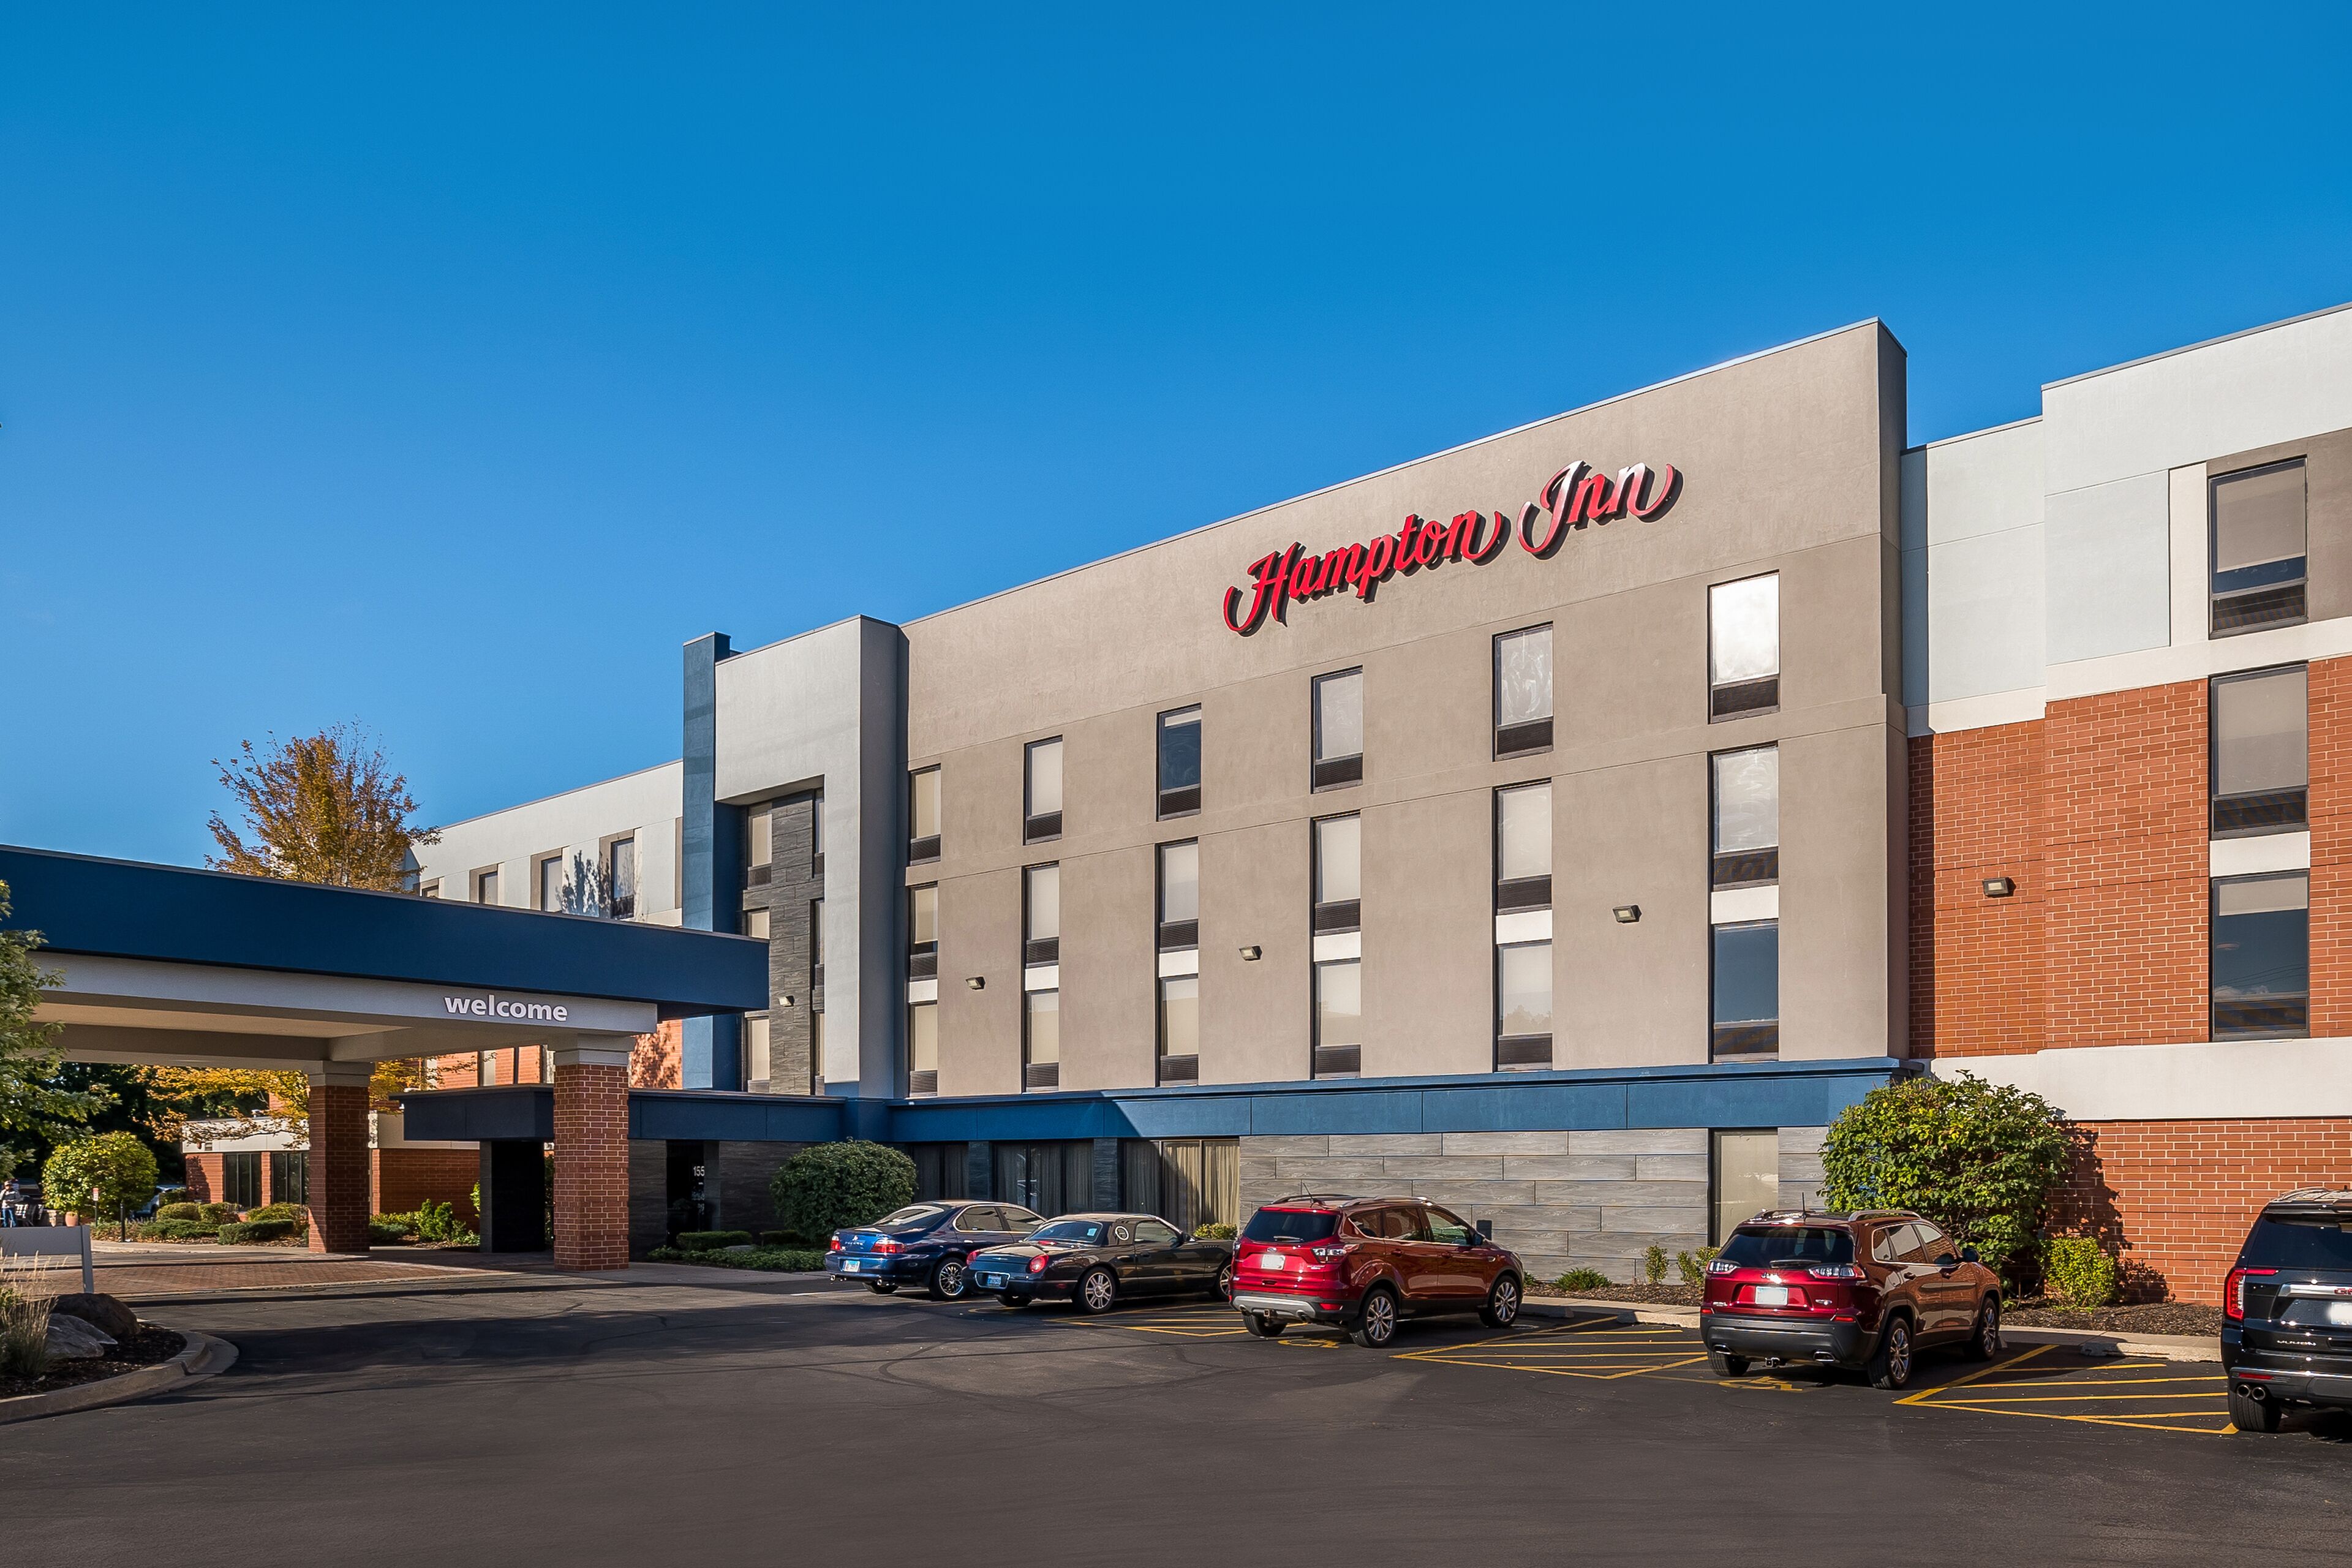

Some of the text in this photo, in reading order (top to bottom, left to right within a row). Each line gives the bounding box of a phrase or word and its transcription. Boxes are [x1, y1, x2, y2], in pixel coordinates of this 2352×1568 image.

[1223, 459, 1682, 636] Hampton Inn
[444, 994, 568, 1022] welcome
[693, 1166, 705, 1177] 155
